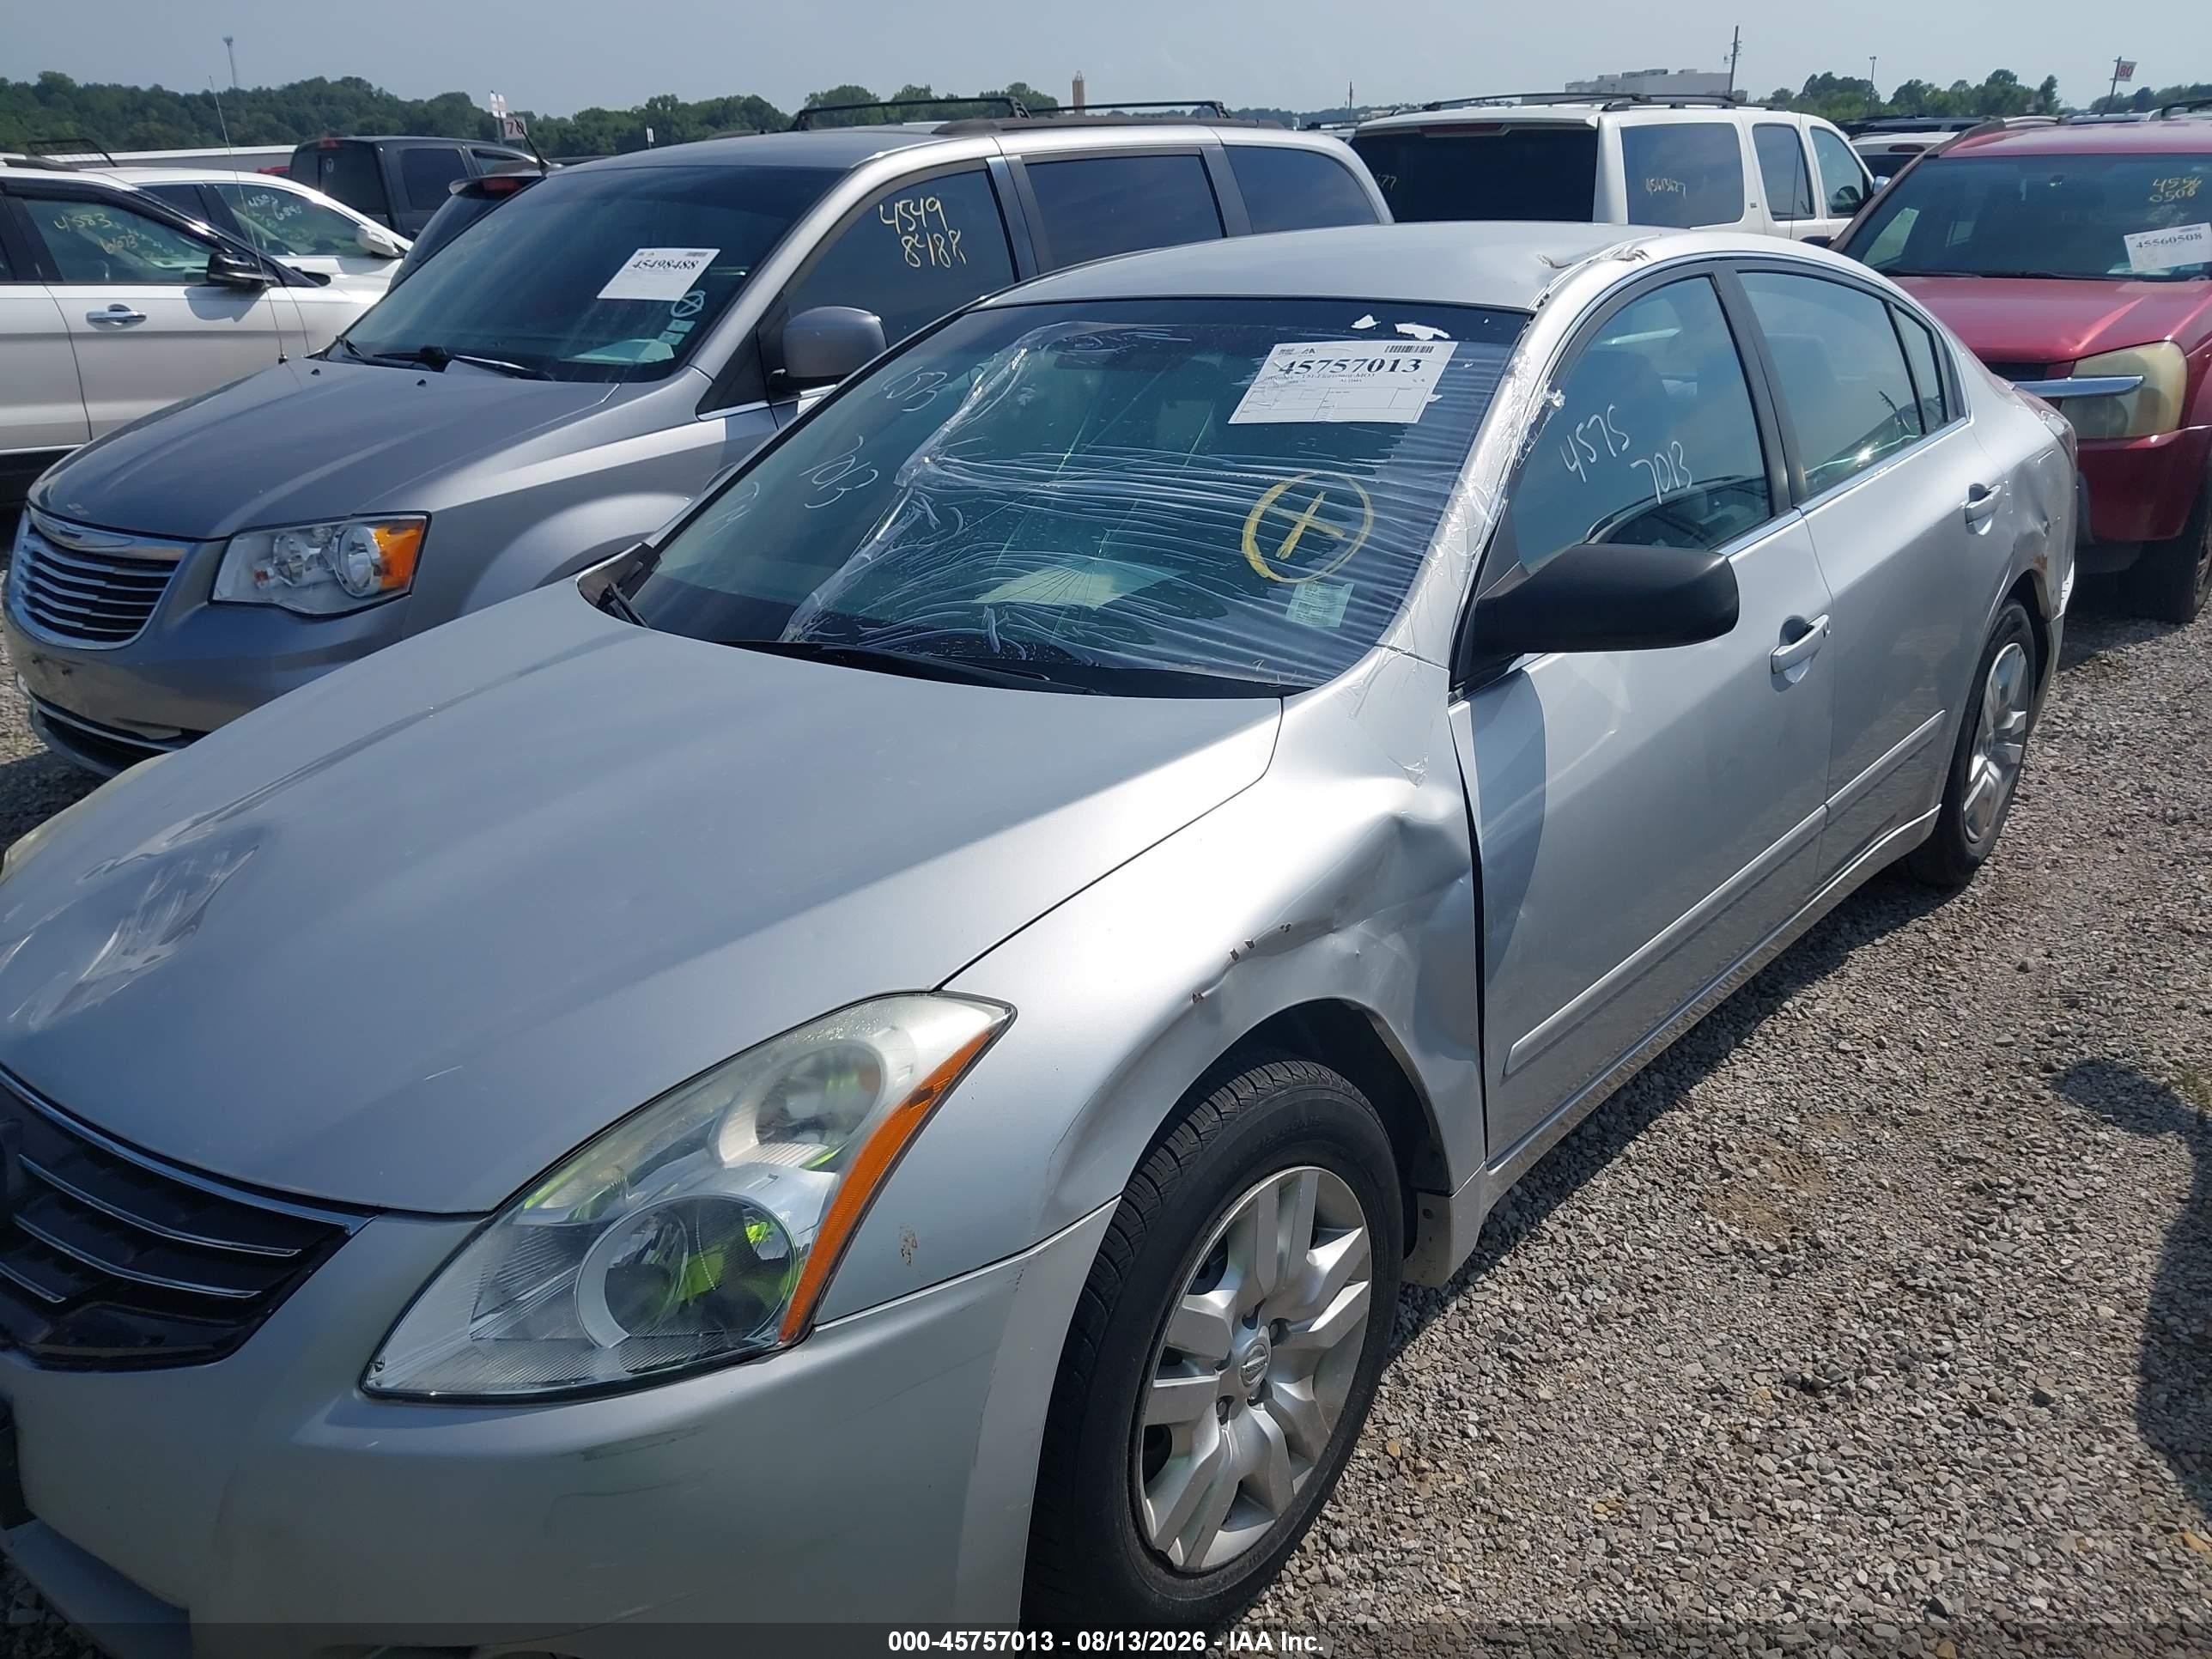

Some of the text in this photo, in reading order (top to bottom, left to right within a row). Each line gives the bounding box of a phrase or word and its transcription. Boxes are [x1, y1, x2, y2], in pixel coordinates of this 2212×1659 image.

[2119, 64, 2135, 77] 80
[505, 121, 525, 135] 70
[878, 196, 948, 234] 4549
[2136, 233, 2203, 248] 45560508
[632, 259, 699, 270] 45498488
[1278, 358, 1422, 375] 45757013
[1559, 404, 1630, 483] 4575
[1630, 441, 1692, 504] 7013
